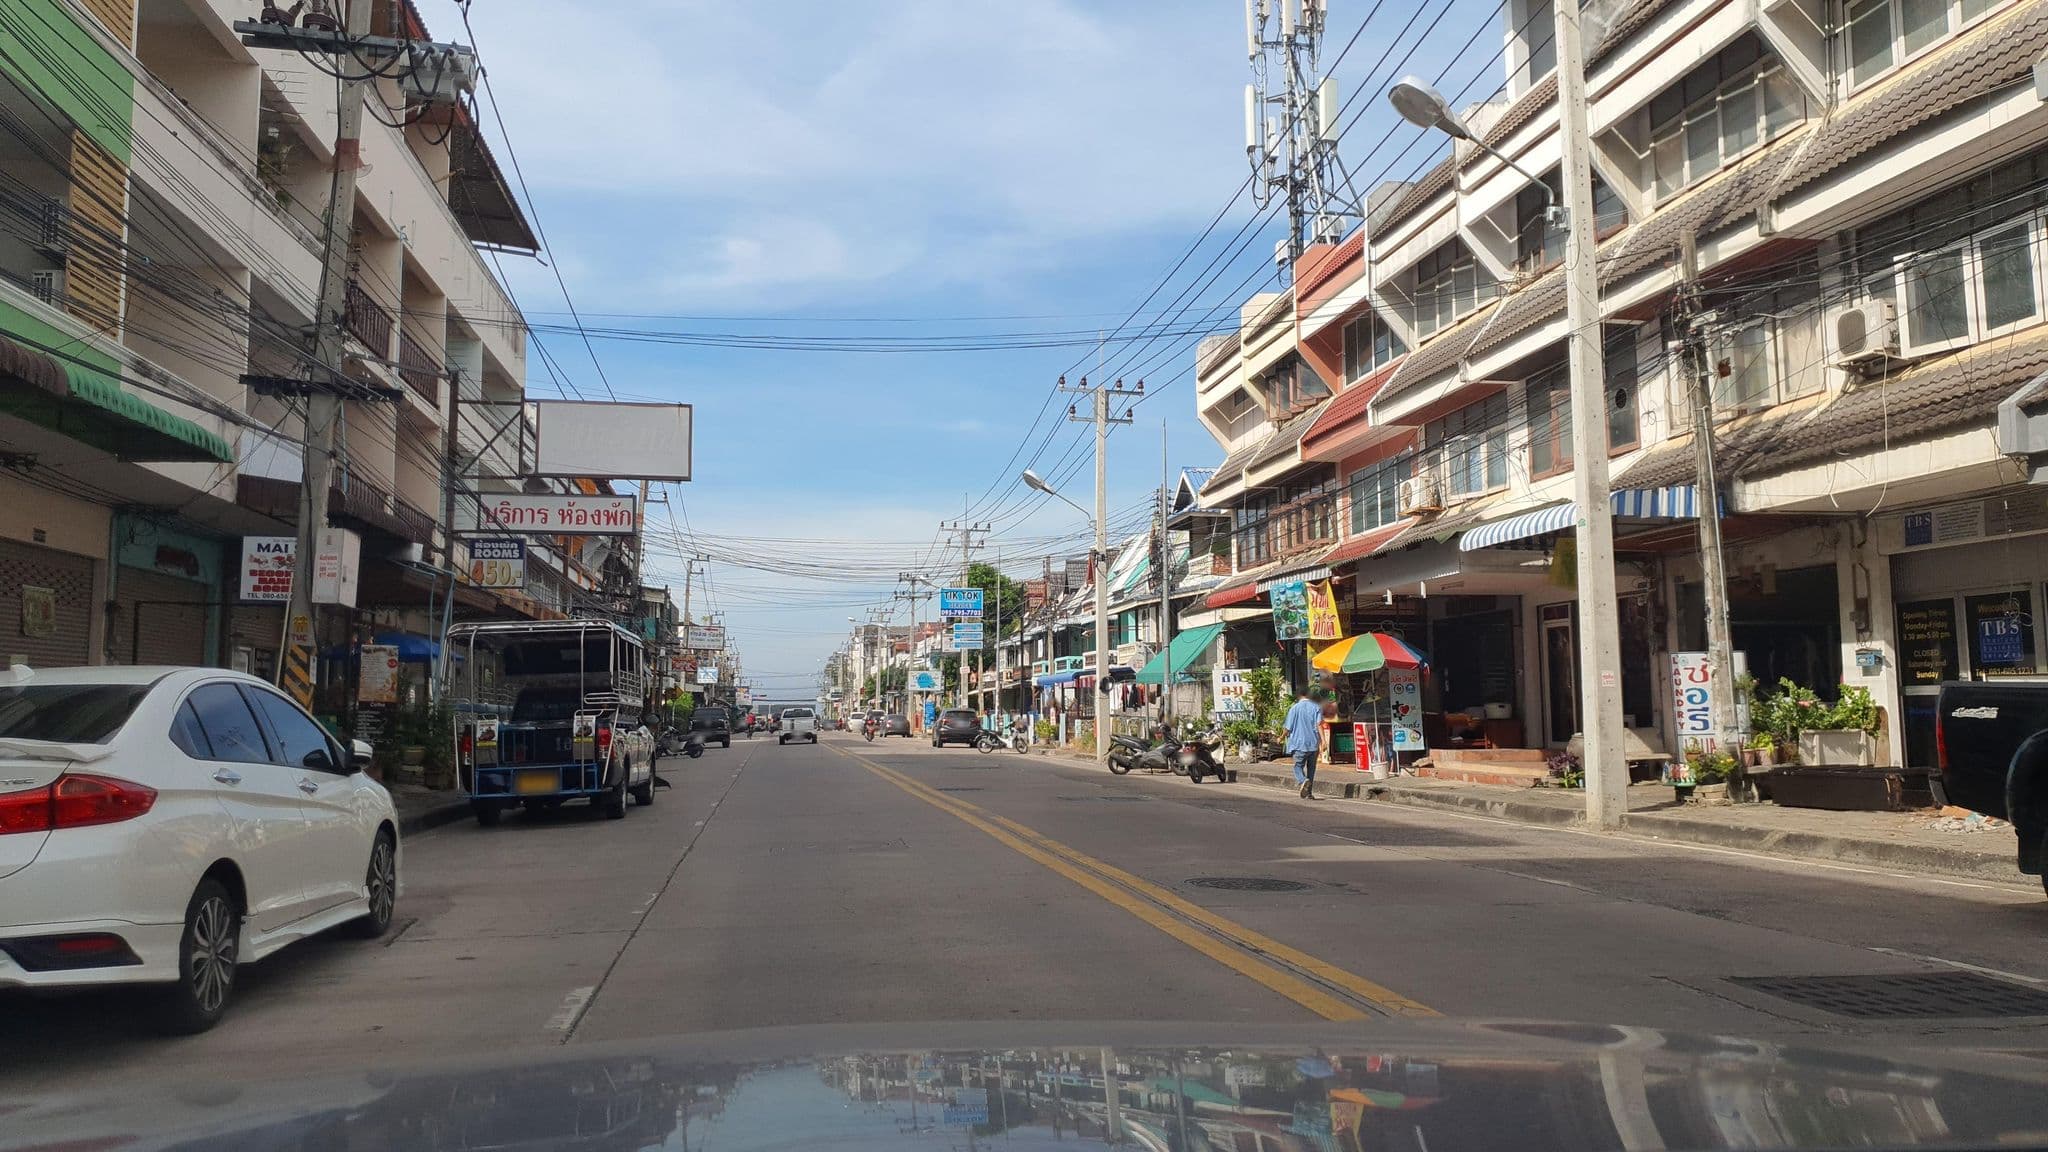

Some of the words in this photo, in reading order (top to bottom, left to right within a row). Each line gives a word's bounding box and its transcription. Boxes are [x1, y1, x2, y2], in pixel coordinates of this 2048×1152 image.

[557, 501, 632, 526] ห้องพัก
[257, 543, 289, 553] MAI
[474, 541, 518, 549] ห้องพัก
[474, 549, 519, 558] ROOMS
[1981, 620, 2020, 636] TBS
[1916, 670, 1939, 679] Sunday
[1672, 656, 1685, 730] LAUNDRY
